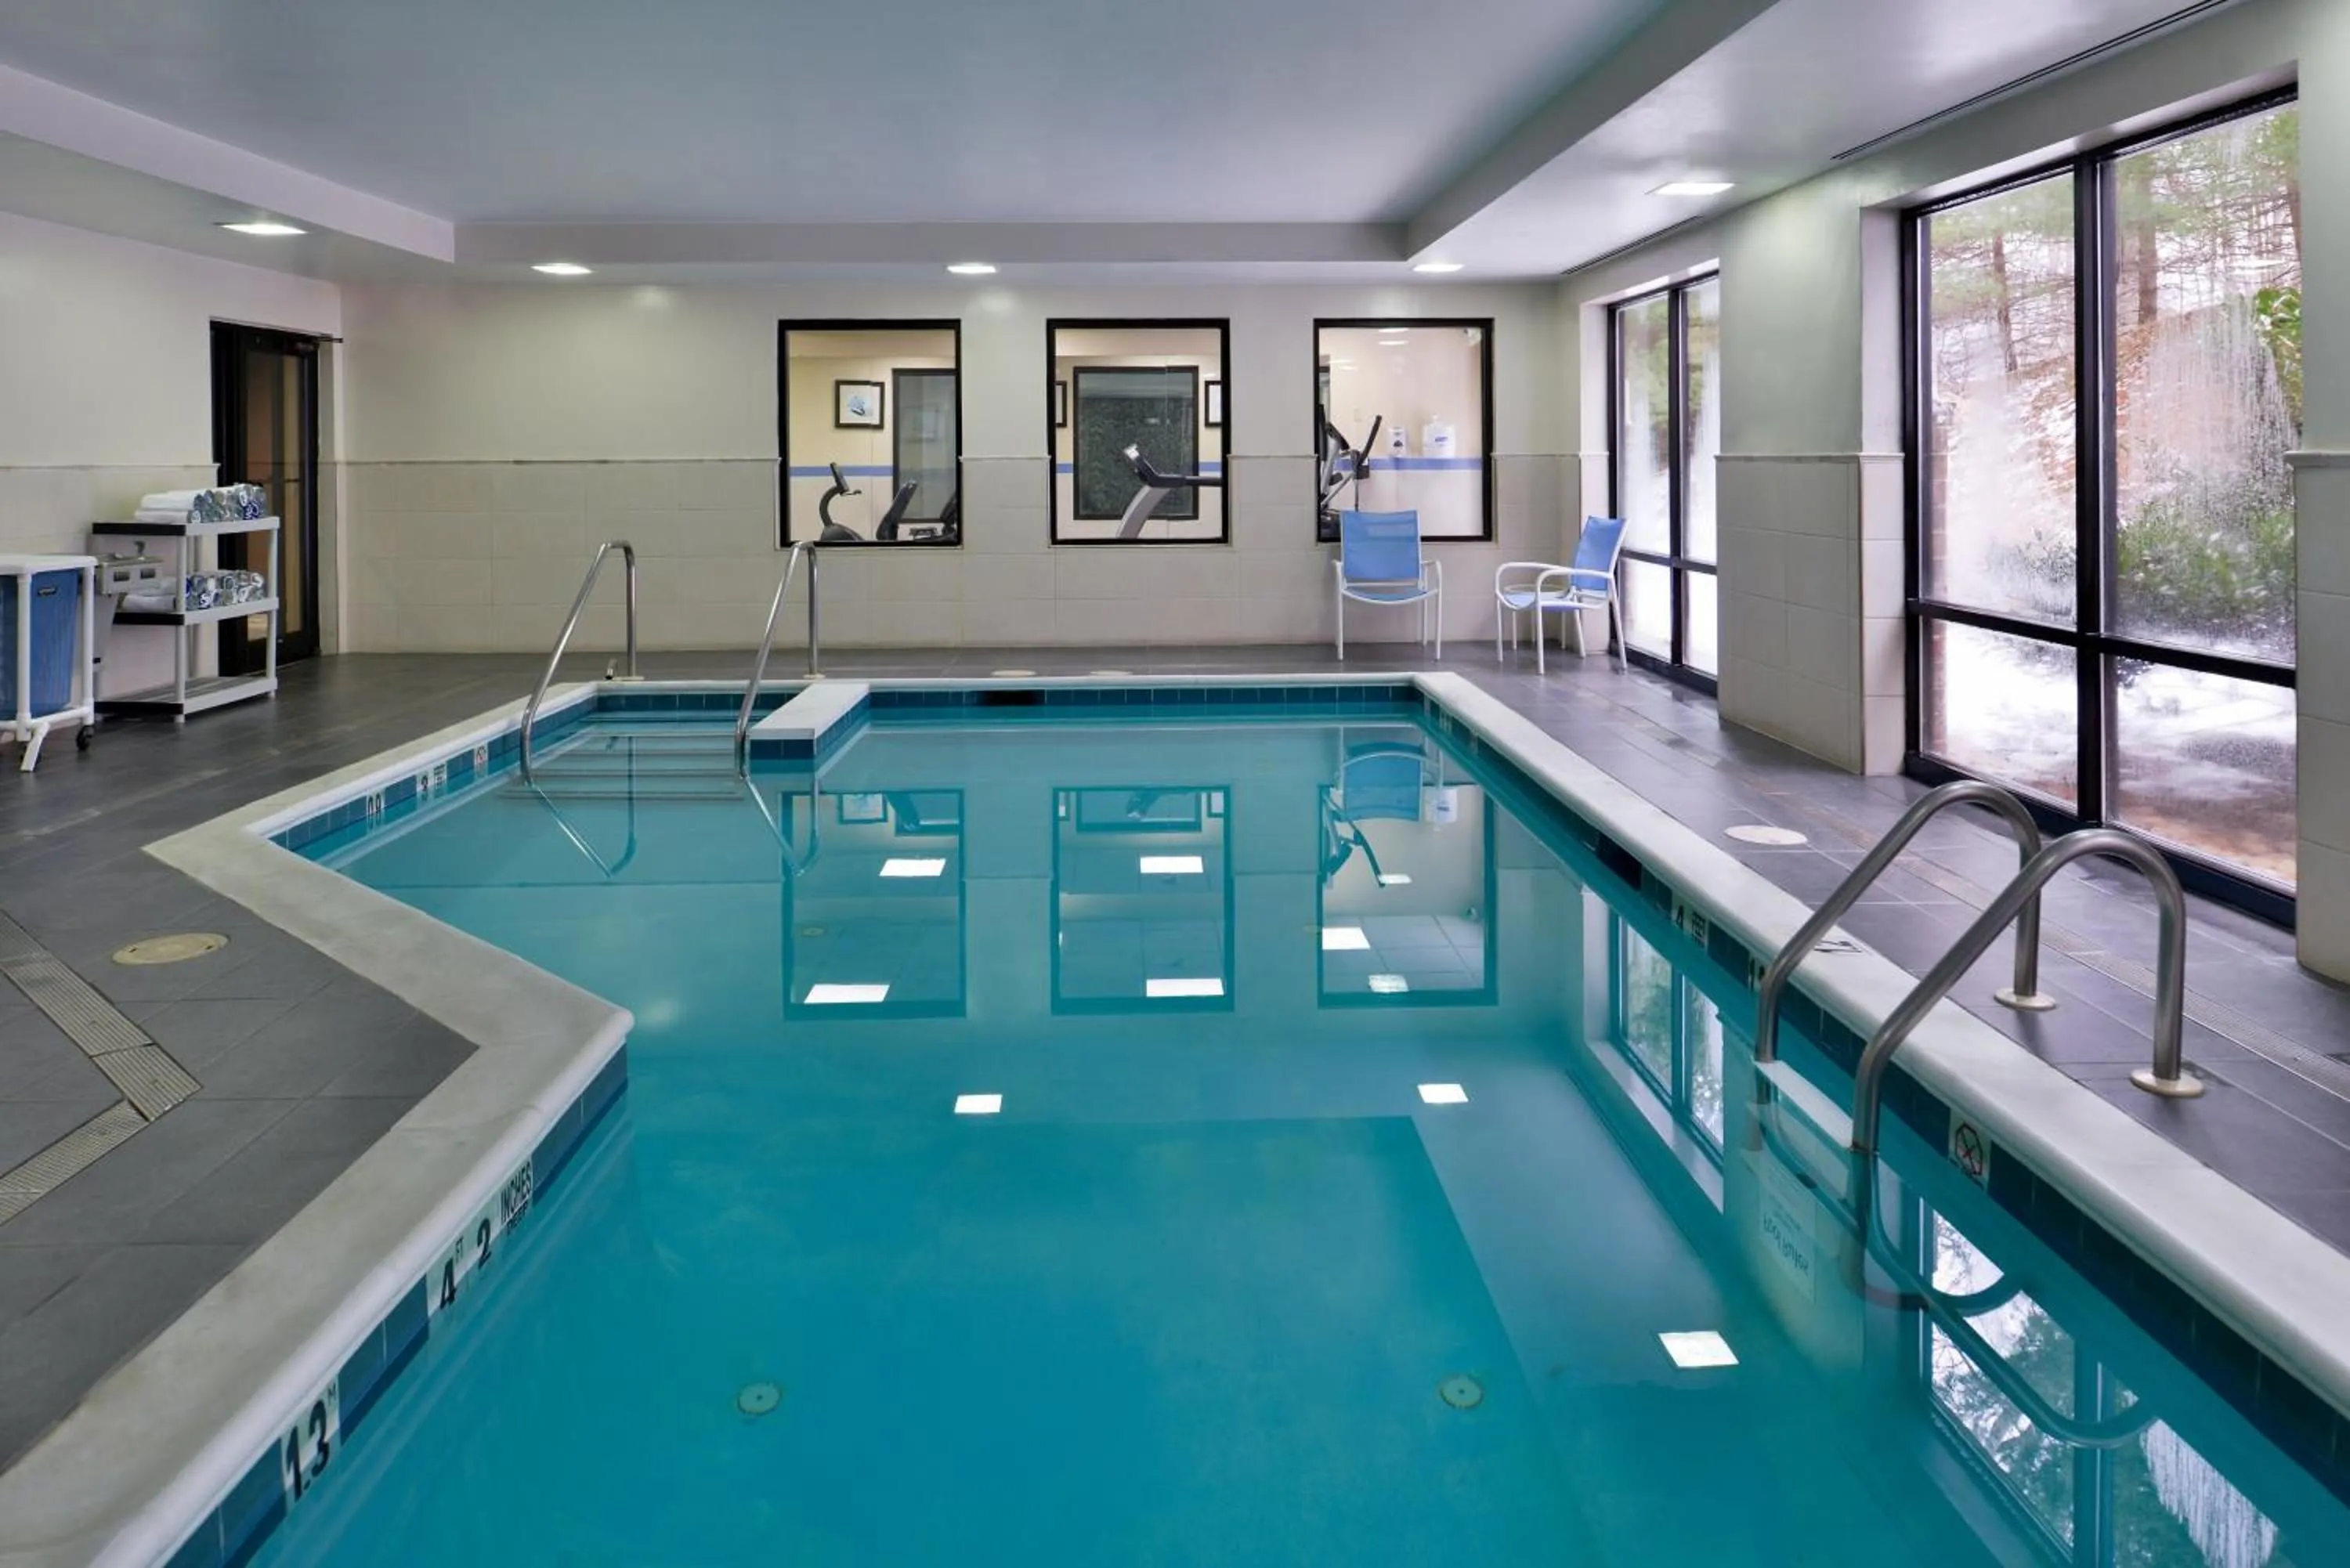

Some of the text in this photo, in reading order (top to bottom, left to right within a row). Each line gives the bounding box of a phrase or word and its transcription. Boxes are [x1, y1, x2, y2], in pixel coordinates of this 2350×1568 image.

[440, 1255, 457, 1310] 4
[477, 1218, 492, 1270] 2
[501, 1160, 531, 1223] INCHES
[286, 1399, 330, 1503] 1.3
